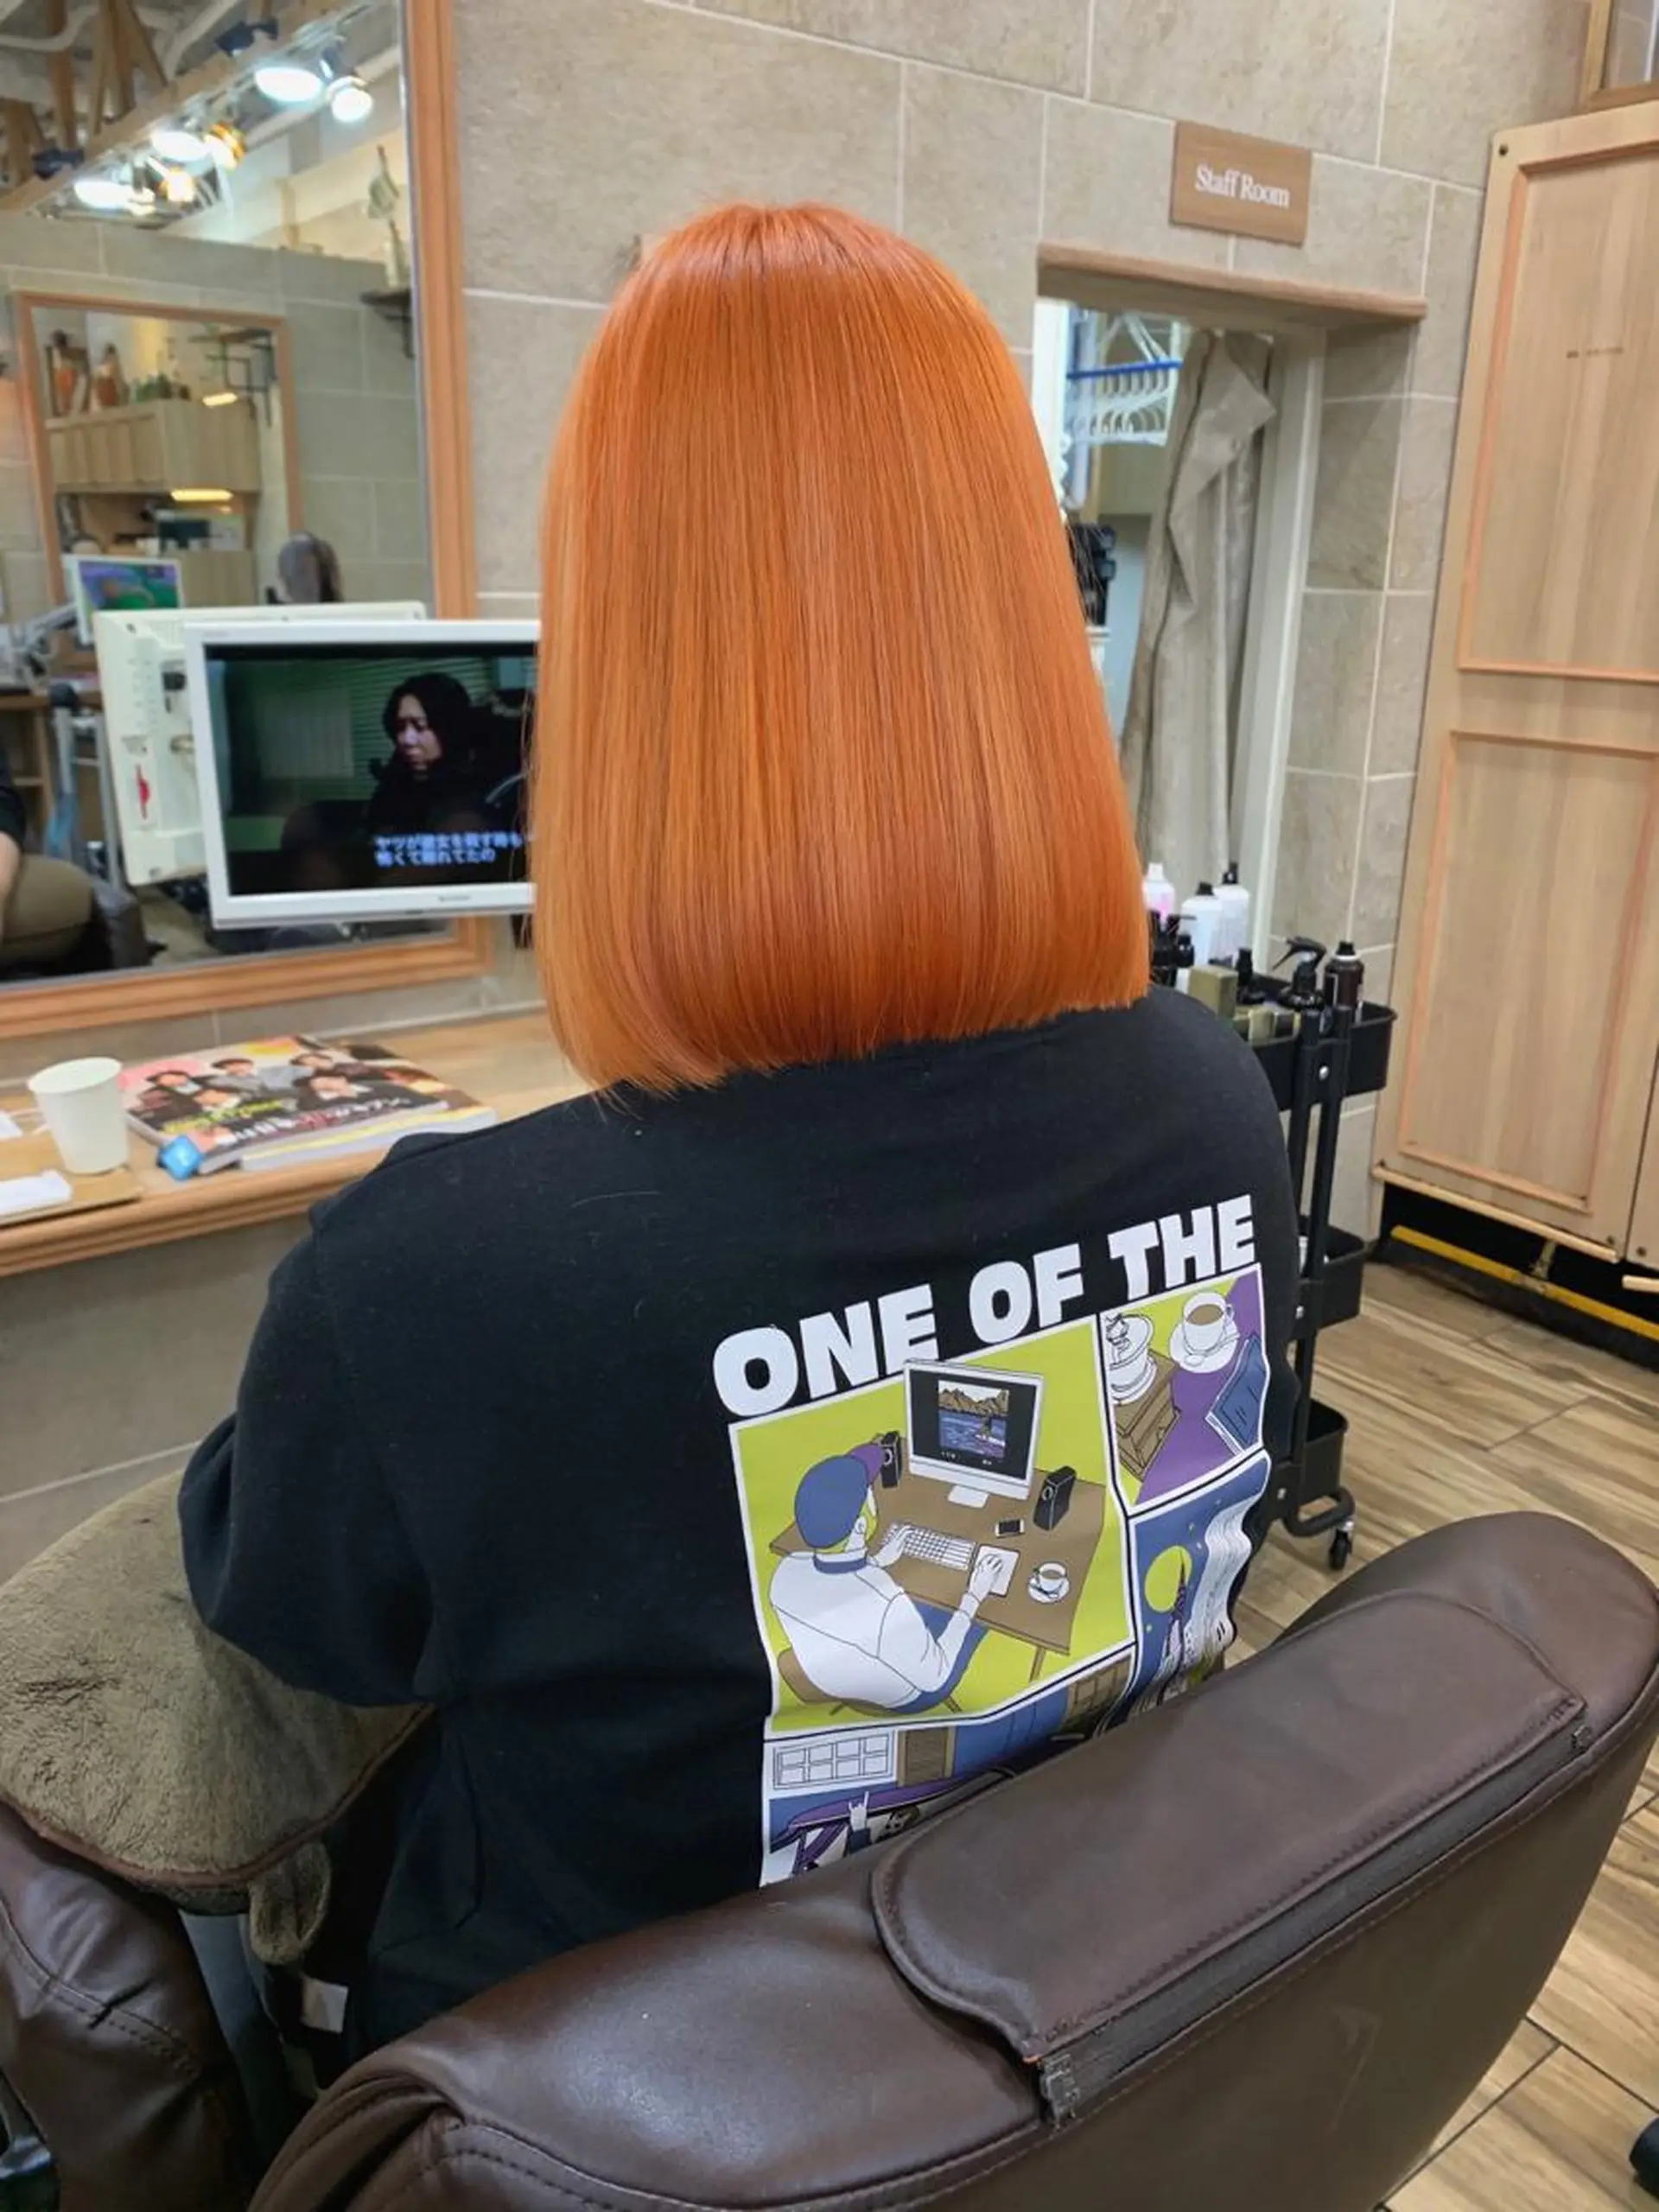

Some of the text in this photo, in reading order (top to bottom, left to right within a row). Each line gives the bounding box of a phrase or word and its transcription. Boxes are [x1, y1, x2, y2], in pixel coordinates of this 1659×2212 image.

[1195, 163, 1291, 208] Staff Room
[713, 1194, 1255, 1417] ONE OF THE
